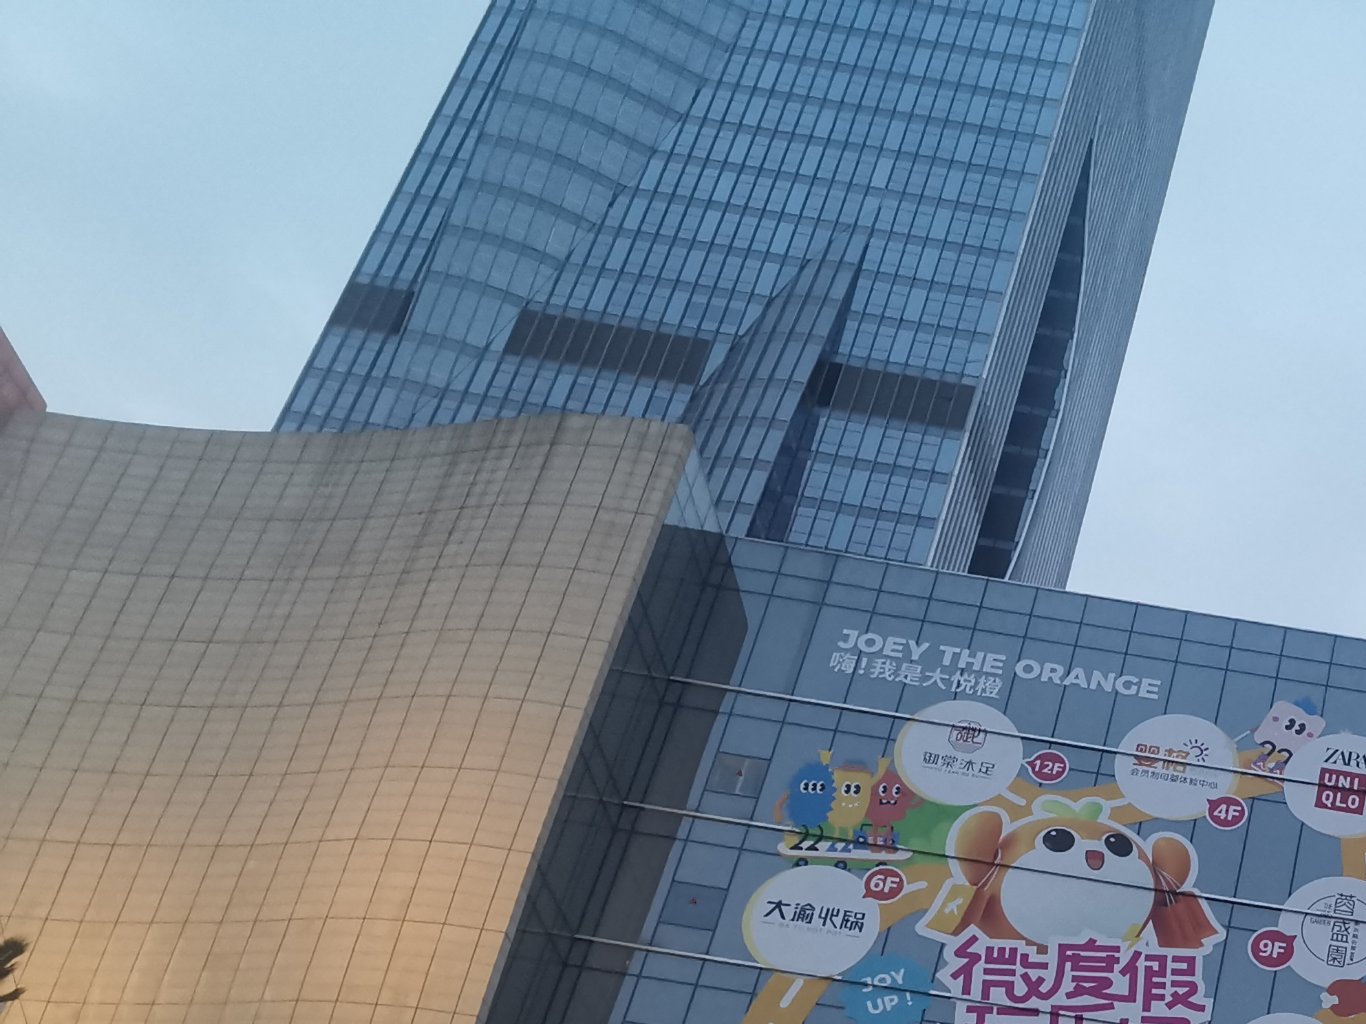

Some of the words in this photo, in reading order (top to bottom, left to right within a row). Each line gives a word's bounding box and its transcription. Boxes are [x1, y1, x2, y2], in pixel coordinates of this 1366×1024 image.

[837, 628, 930, 661] JOEY
[939, 644, 1006, 675] THE
[1014, 659, 1162, 700] ORANGE
[1033, 760, 1064, 775] 12F
[1324, 773, 1359, 790] UNI
[1322, 791, 1359, 809] QLO
[1213, 804, 1241, 821] 4F
[870, 875, 899, 893] 6F
[763, 900, 865, 933] 大渝火锅
[1259, 940, 1286, 958] 9F
[861, 968, 904, 993] JOY
[950, 934, 1206, 1013] 微度假
